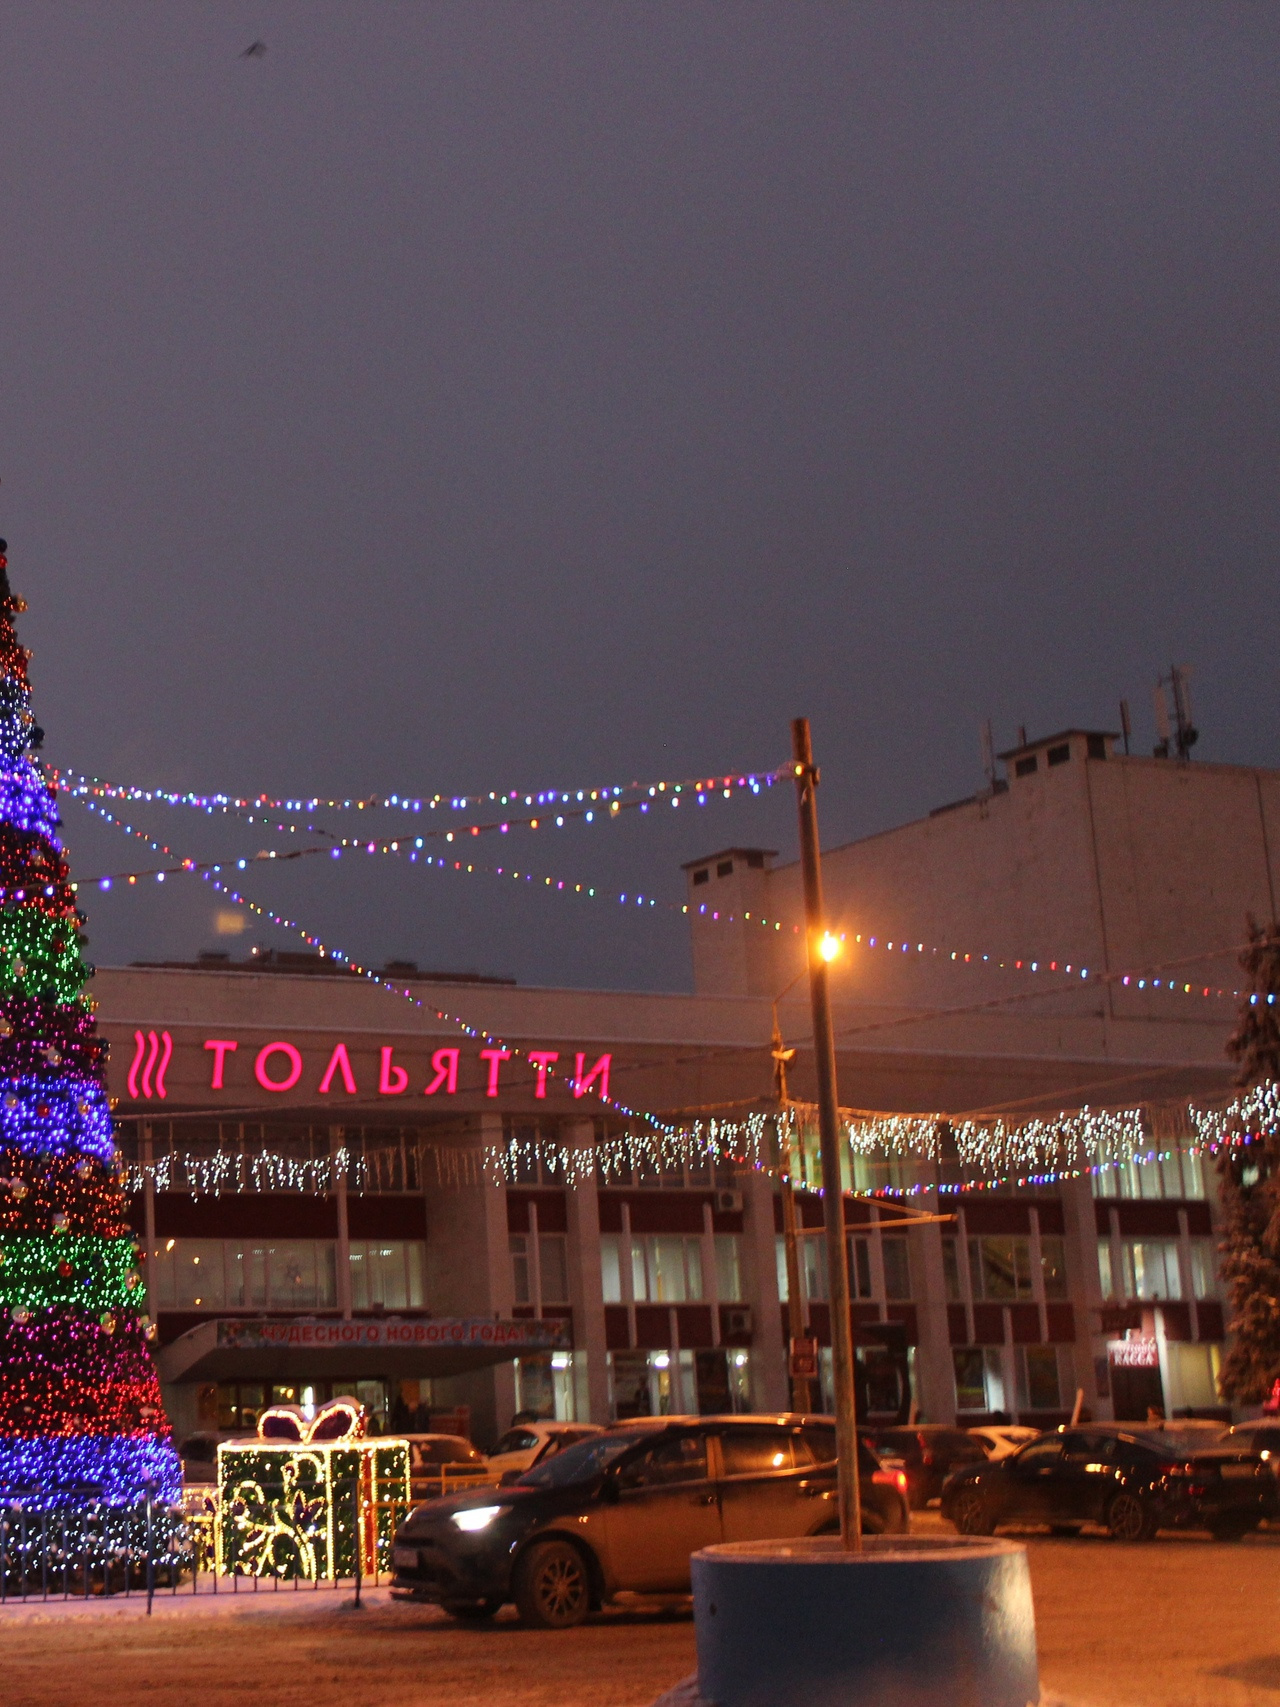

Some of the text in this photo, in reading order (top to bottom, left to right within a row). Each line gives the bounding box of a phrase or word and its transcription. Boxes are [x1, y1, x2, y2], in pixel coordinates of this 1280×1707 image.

[203, 1039, 612, 1099] ТОЛЬЯТТИ
[386, 1325, 464, 1342] НОВОГО
[1113, 1351, 1154, 1366] КАССА
